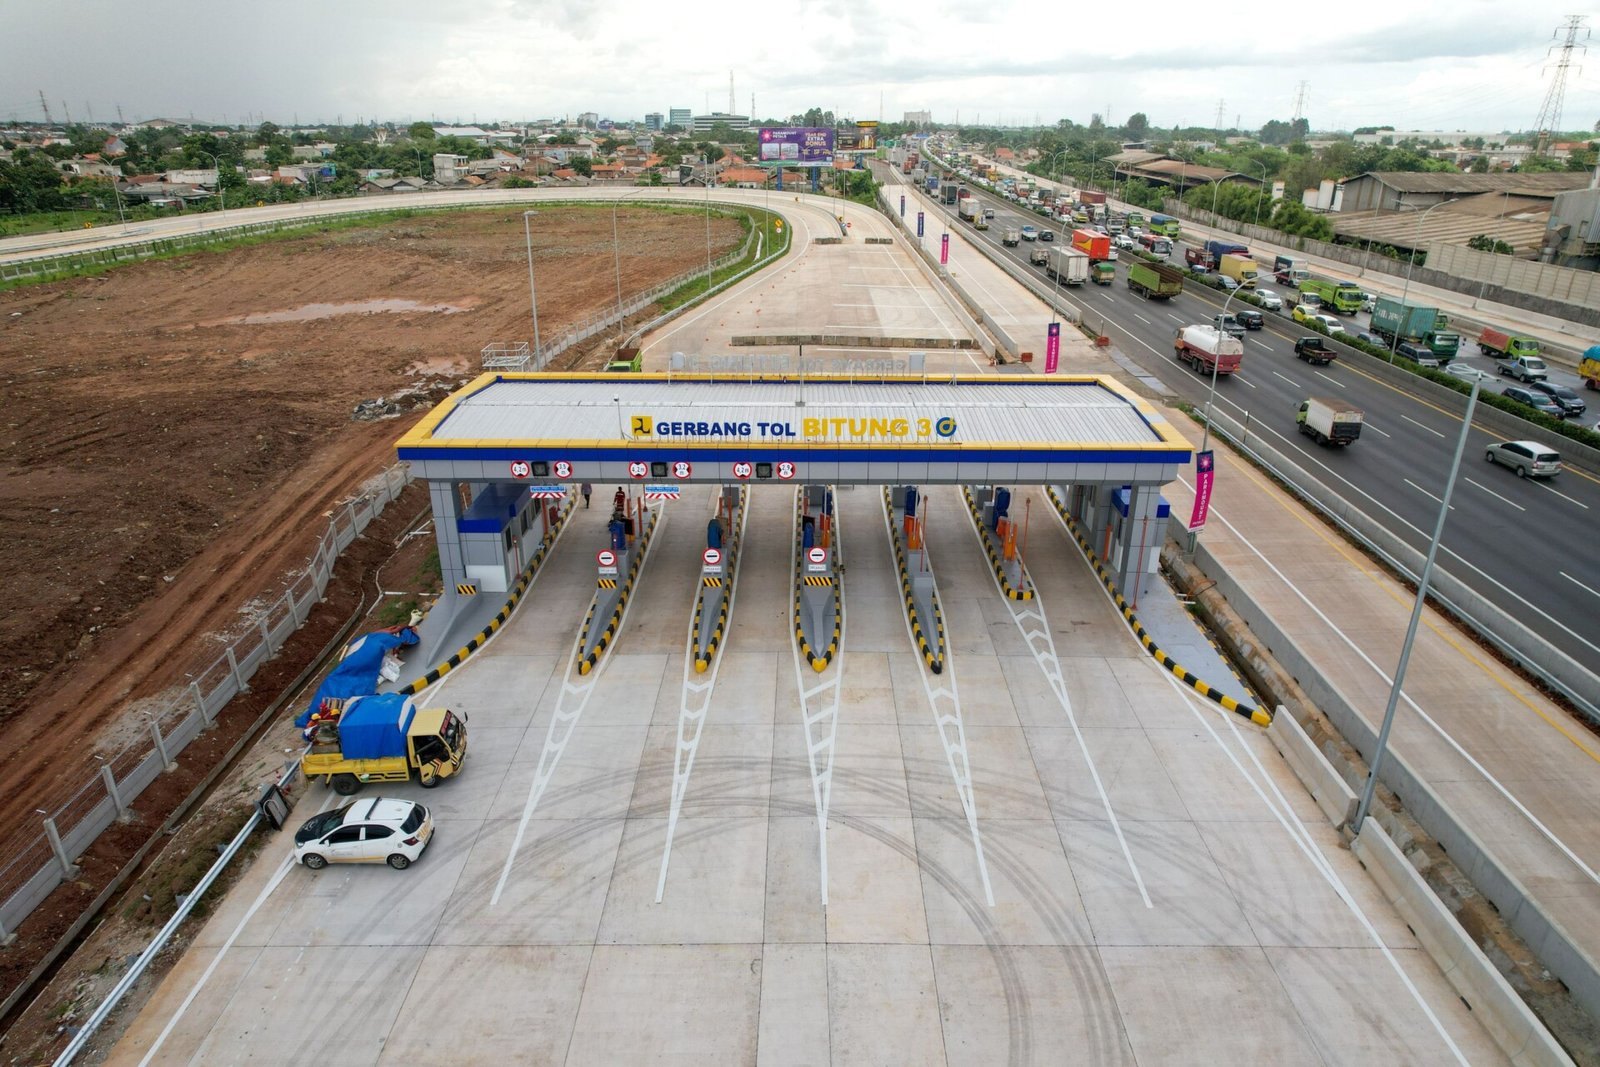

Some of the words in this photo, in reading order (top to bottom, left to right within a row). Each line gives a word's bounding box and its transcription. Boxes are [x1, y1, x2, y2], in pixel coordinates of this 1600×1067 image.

[656, 421, 751, 436] GERBANG
[757, 422, 796, 436] TOL
[802, 417, 909, 437] BITUNG
[916, 417, 932, 437] 3
[1199, 473, 1208, 519] PARAMOUNT
